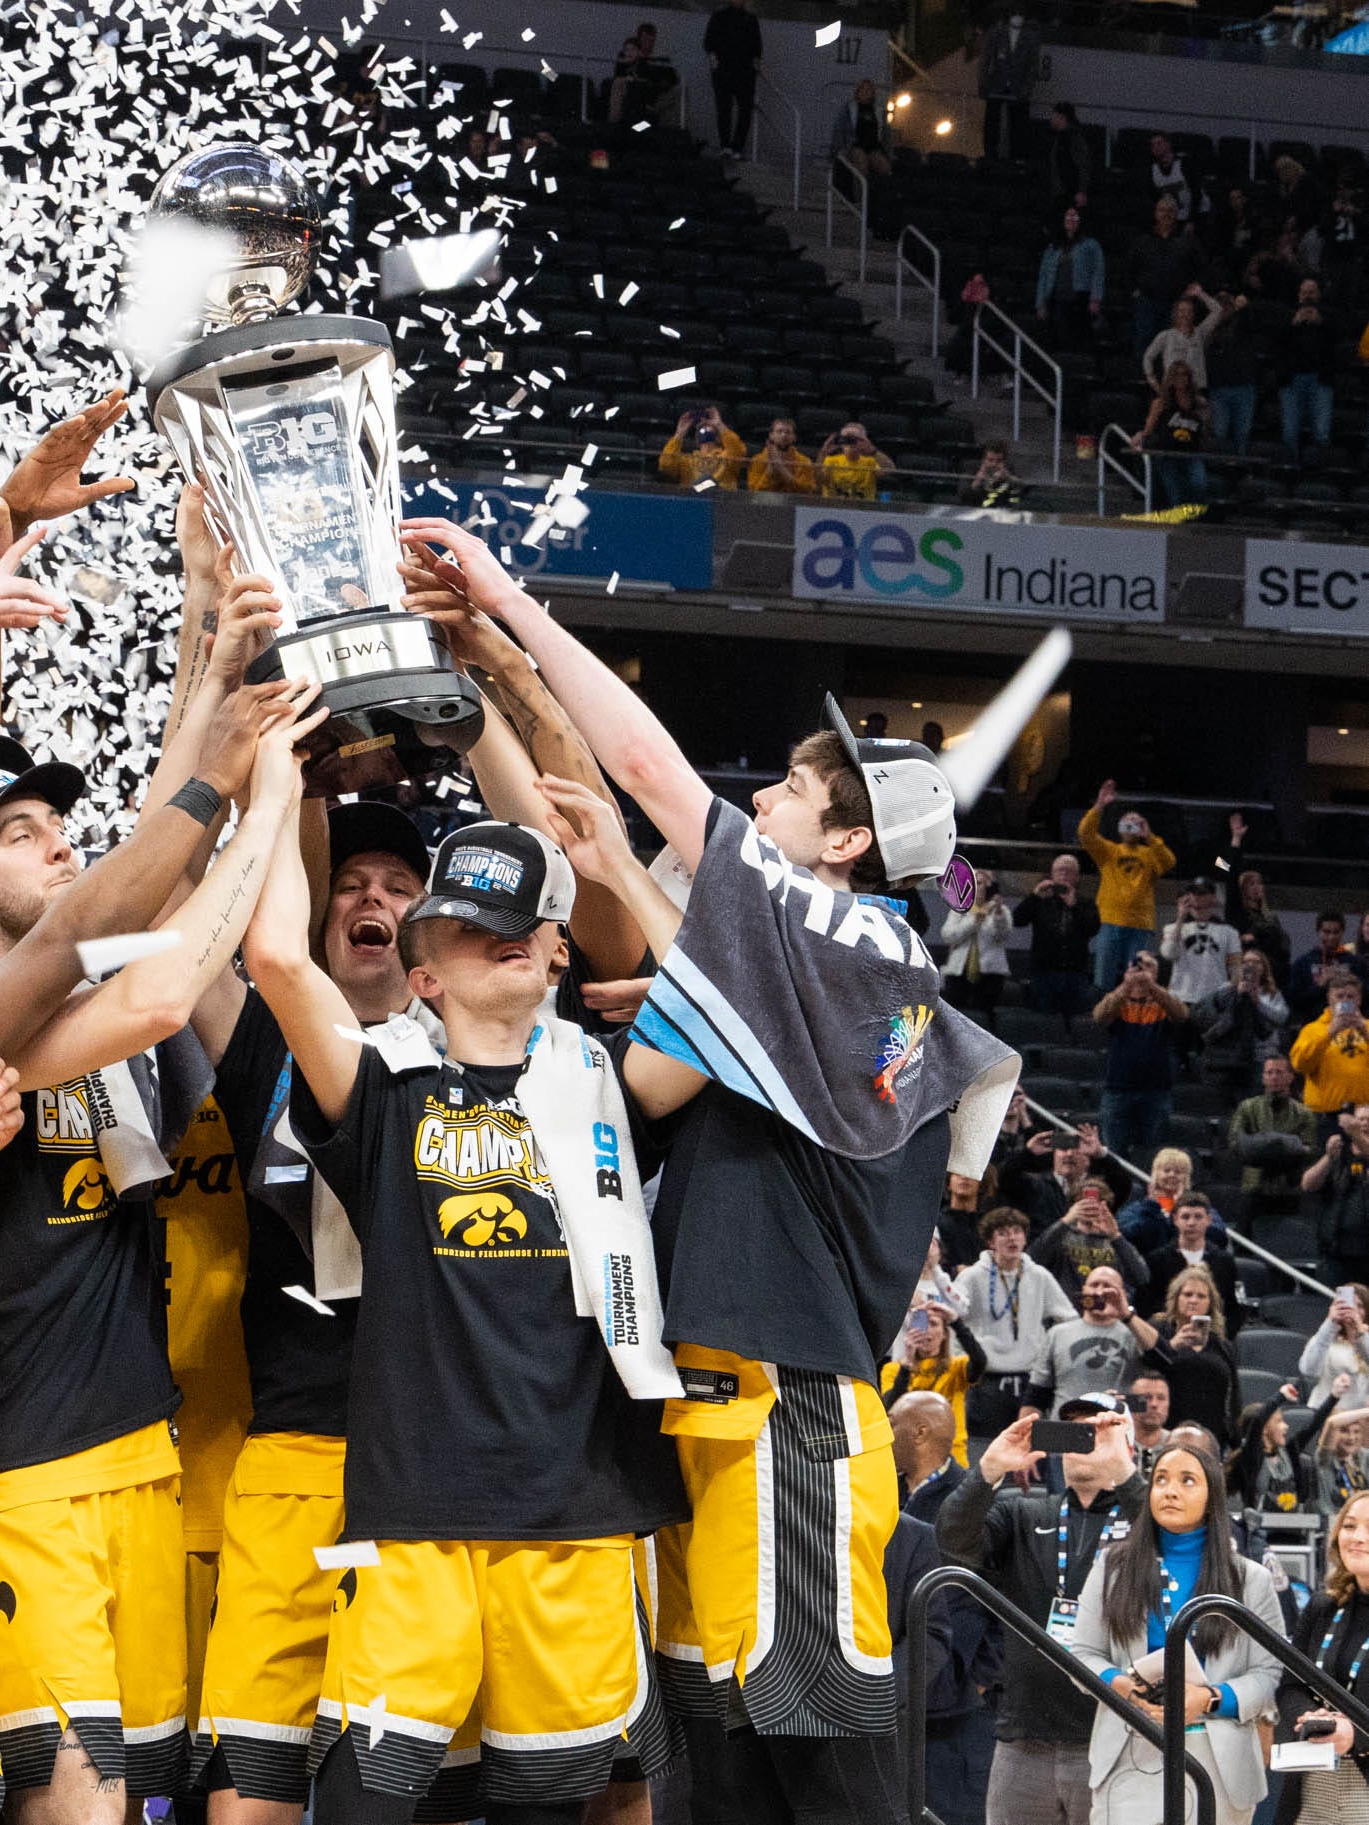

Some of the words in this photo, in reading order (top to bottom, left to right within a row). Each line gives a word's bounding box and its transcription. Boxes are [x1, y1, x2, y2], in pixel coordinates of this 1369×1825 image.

[802, 519, 964, 598] aes
[984, 554, 1158, 612] Indiana
[326, 640, 392, 663] IOWA
[450, 855, 521, 888] CHAMPIONS
[610, 1252, 626, 1346] TOURNAMENT
[621, 1254, 639, 1346] CHAMPIONS
